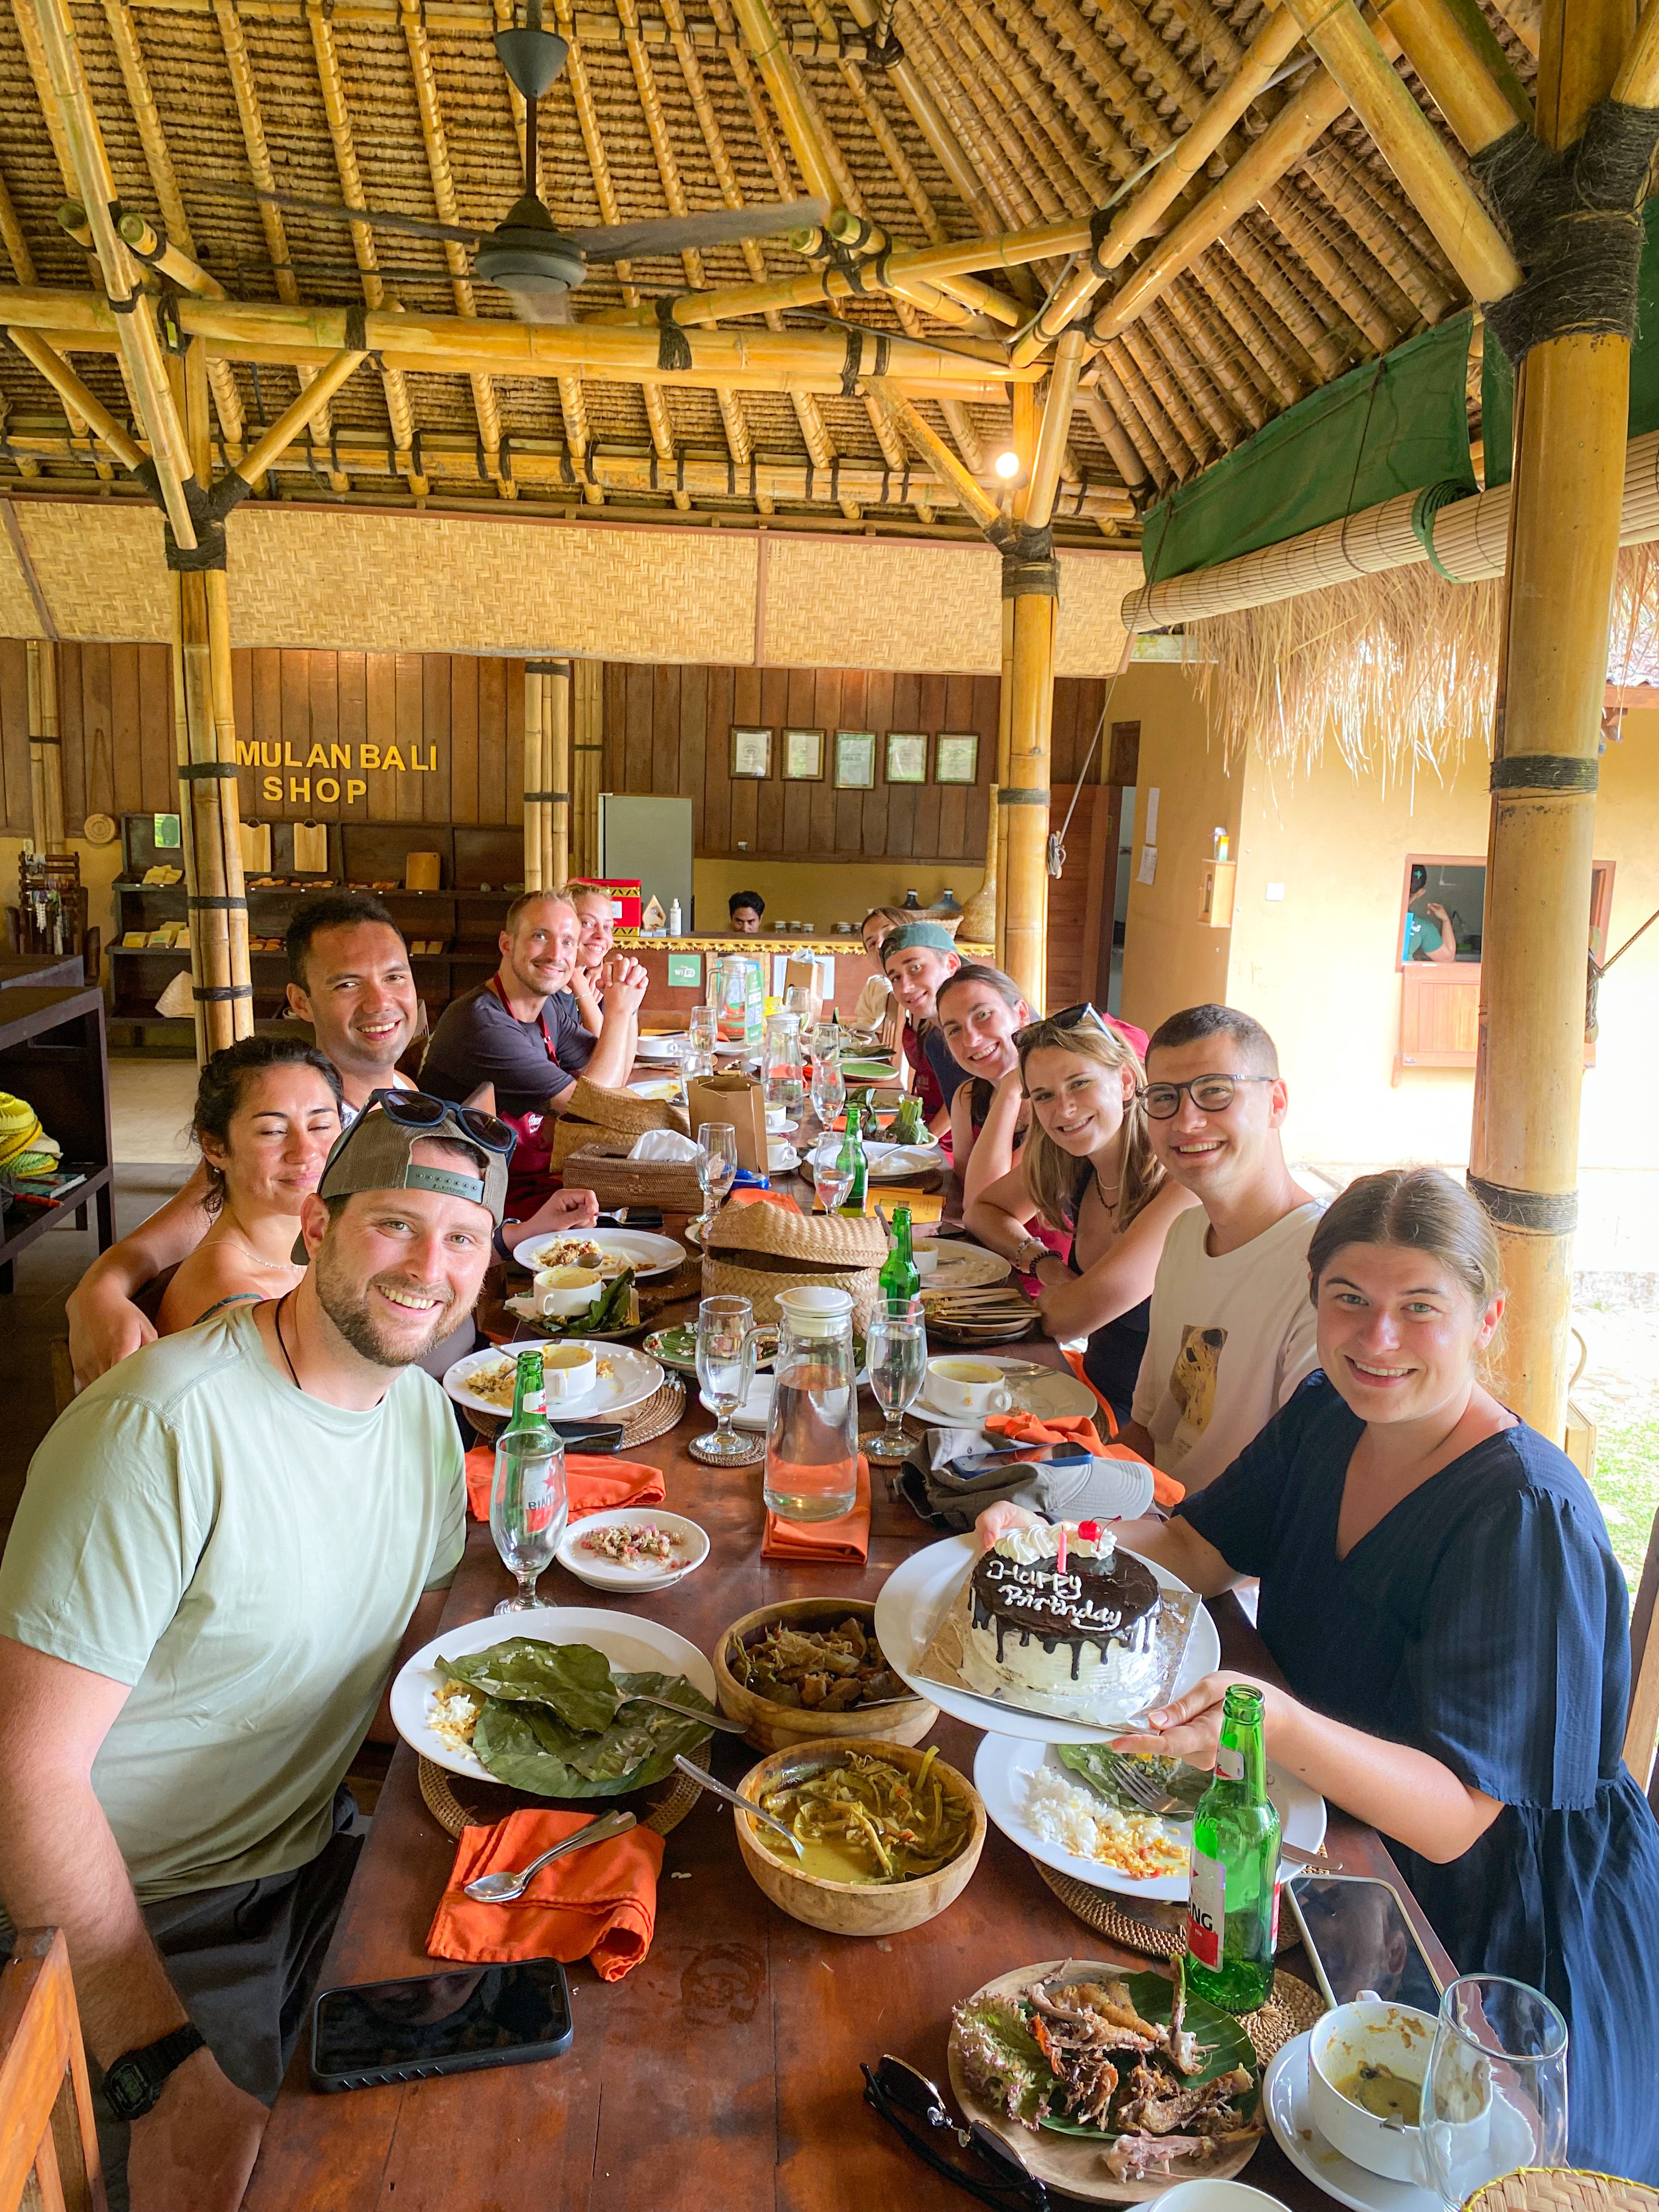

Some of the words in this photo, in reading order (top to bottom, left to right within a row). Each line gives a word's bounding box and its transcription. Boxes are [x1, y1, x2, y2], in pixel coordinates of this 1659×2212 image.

[236, 740, 351, 769] MULAN
[360, 743, 437, 771] BALI
[262, 776, 367, 804] SHOP
[987, 1560, 1082, 1600] Happy
[998, 1584, 1122, 1632] Birthday
